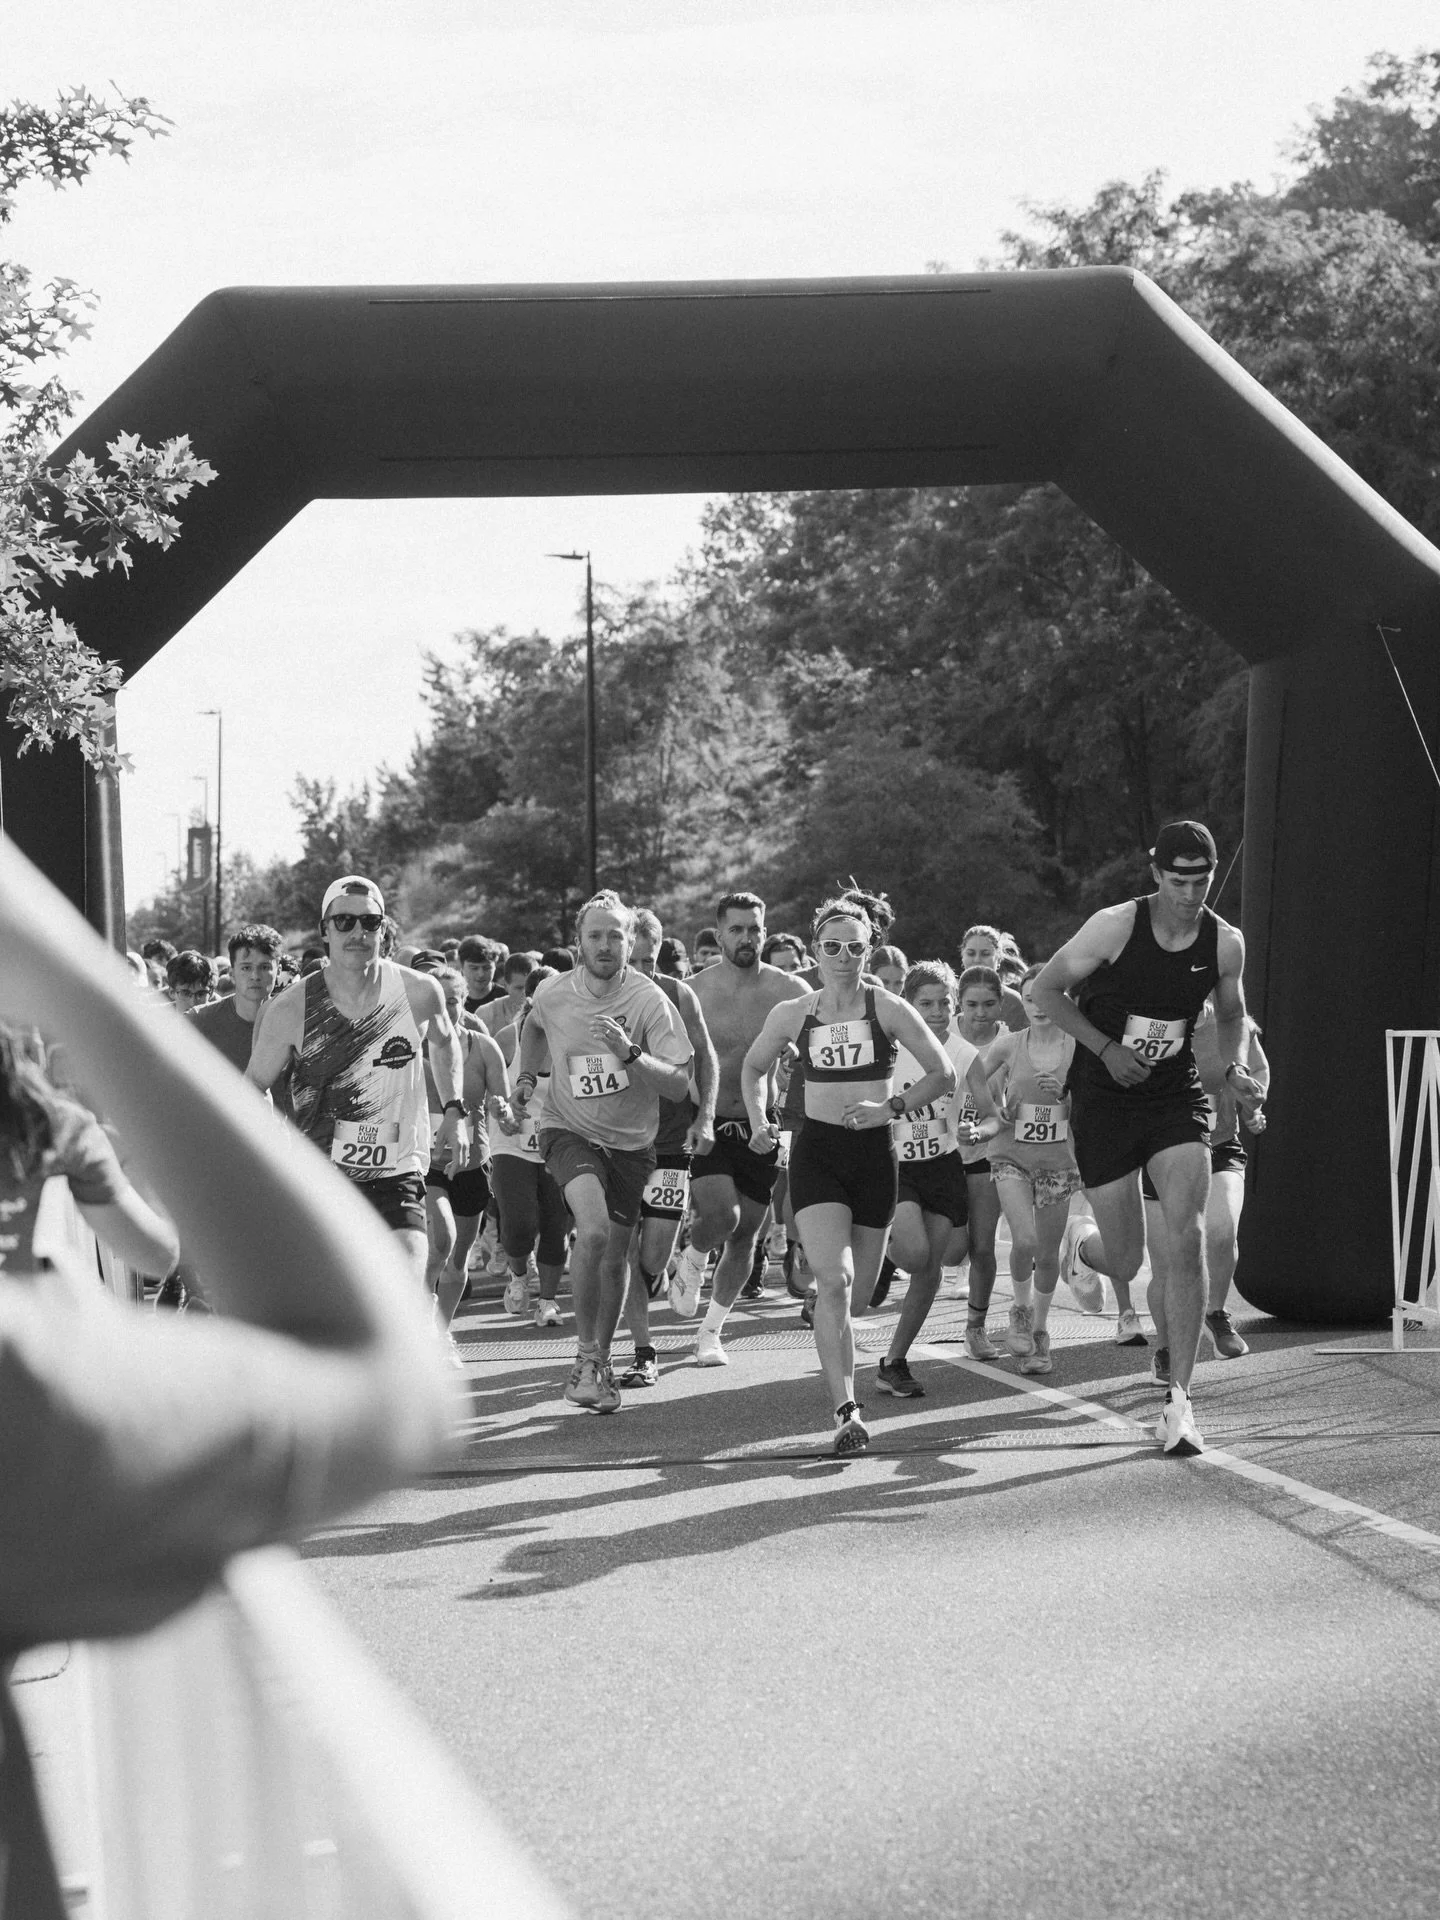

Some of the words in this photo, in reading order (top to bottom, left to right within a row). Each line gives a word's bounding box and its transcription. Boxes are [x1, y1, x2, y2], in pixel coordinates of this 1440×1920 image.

[831, 1025, 848, 1033] RUN
[1150, 1021, 1168, 1030] RUN
[821, 1043, 862, 1067] 317
[1133, 1038, 1174, 1058] 267
[580, 1073, 619, 1095] 314
[359, 1125, 379, 1133] RUN
[1023, 1122, 1057, 1141] 291
[341, 1143, 387, 1166] 220
[903, 1137, 940, 1159] 315
[651, 1187, 685, 1208] 282
